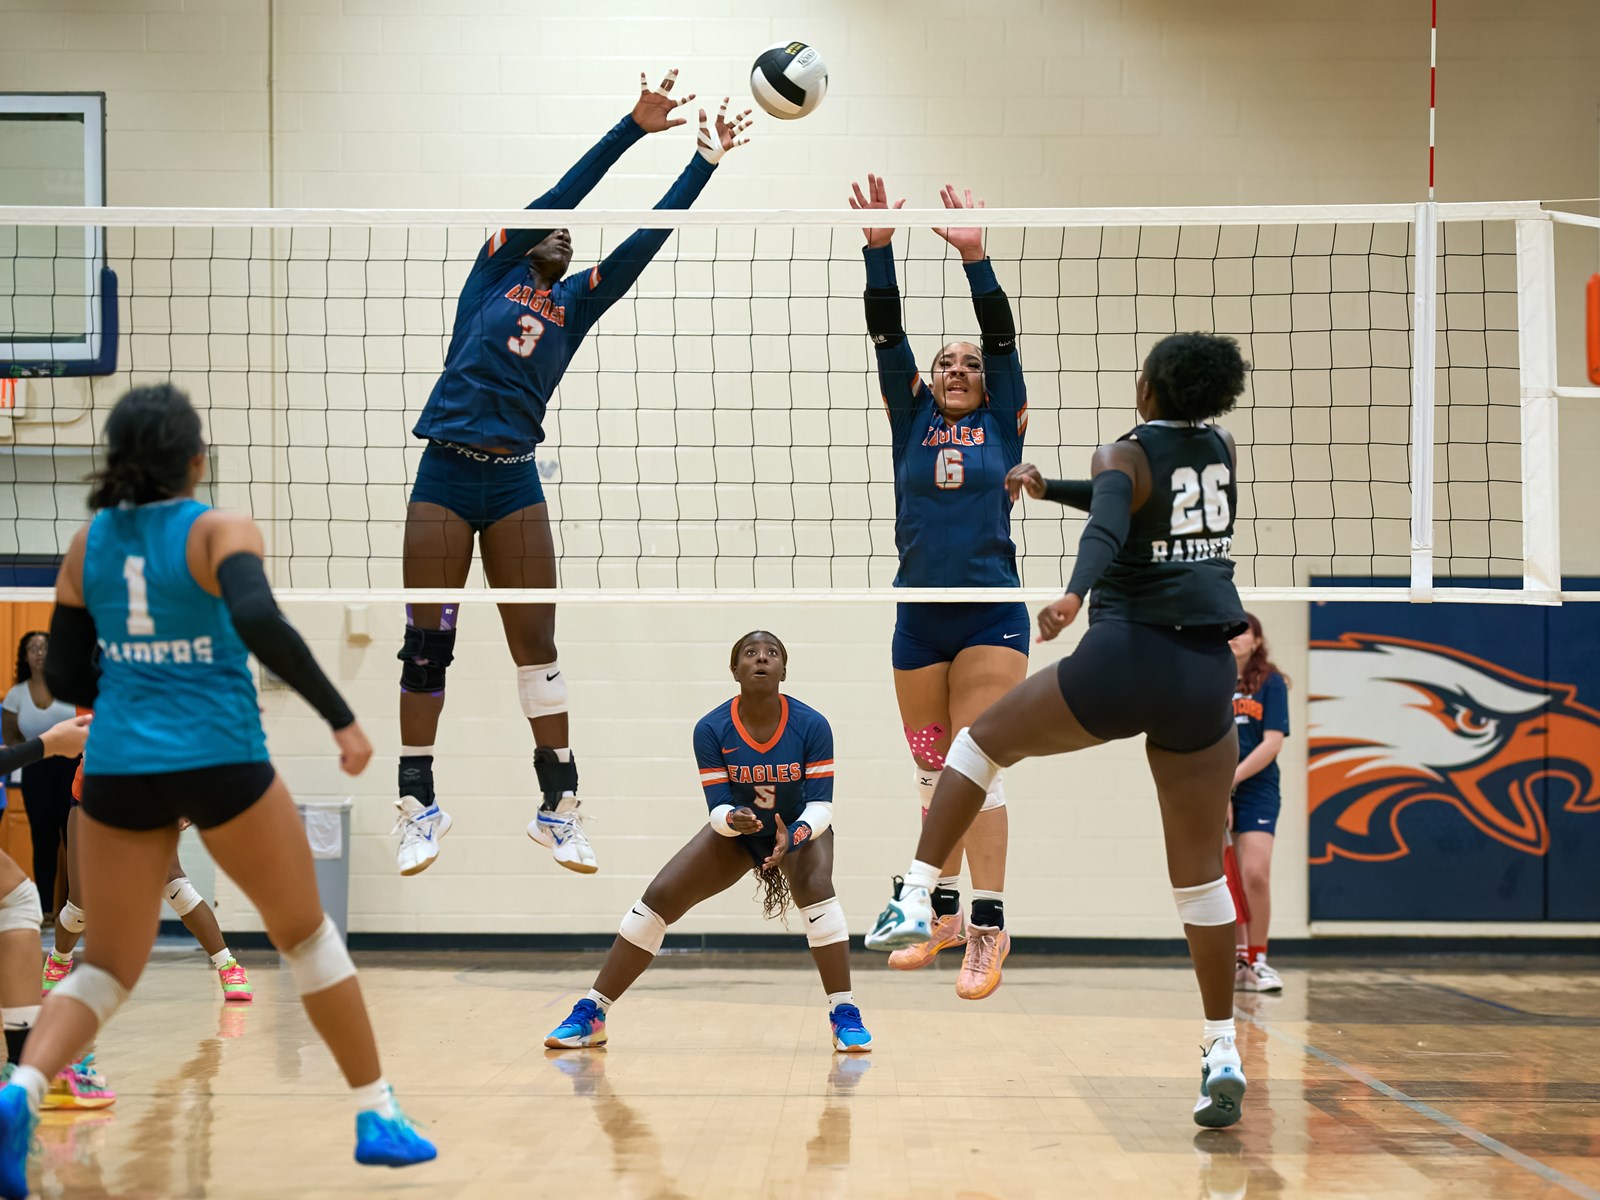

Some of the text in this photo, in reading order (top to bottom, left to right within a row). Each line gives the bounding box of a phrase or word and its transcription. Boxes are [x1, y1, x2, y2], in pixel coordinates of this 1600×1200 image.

[507, 313, 545, 357] 3
[934, 448, 964, 491] 6
[1170, 463, 1230, 535] 26
[123, 555, 155, 636] 1
[727, 762, 802, 783] EAGLES
[753, 784, 777, 810] 5
